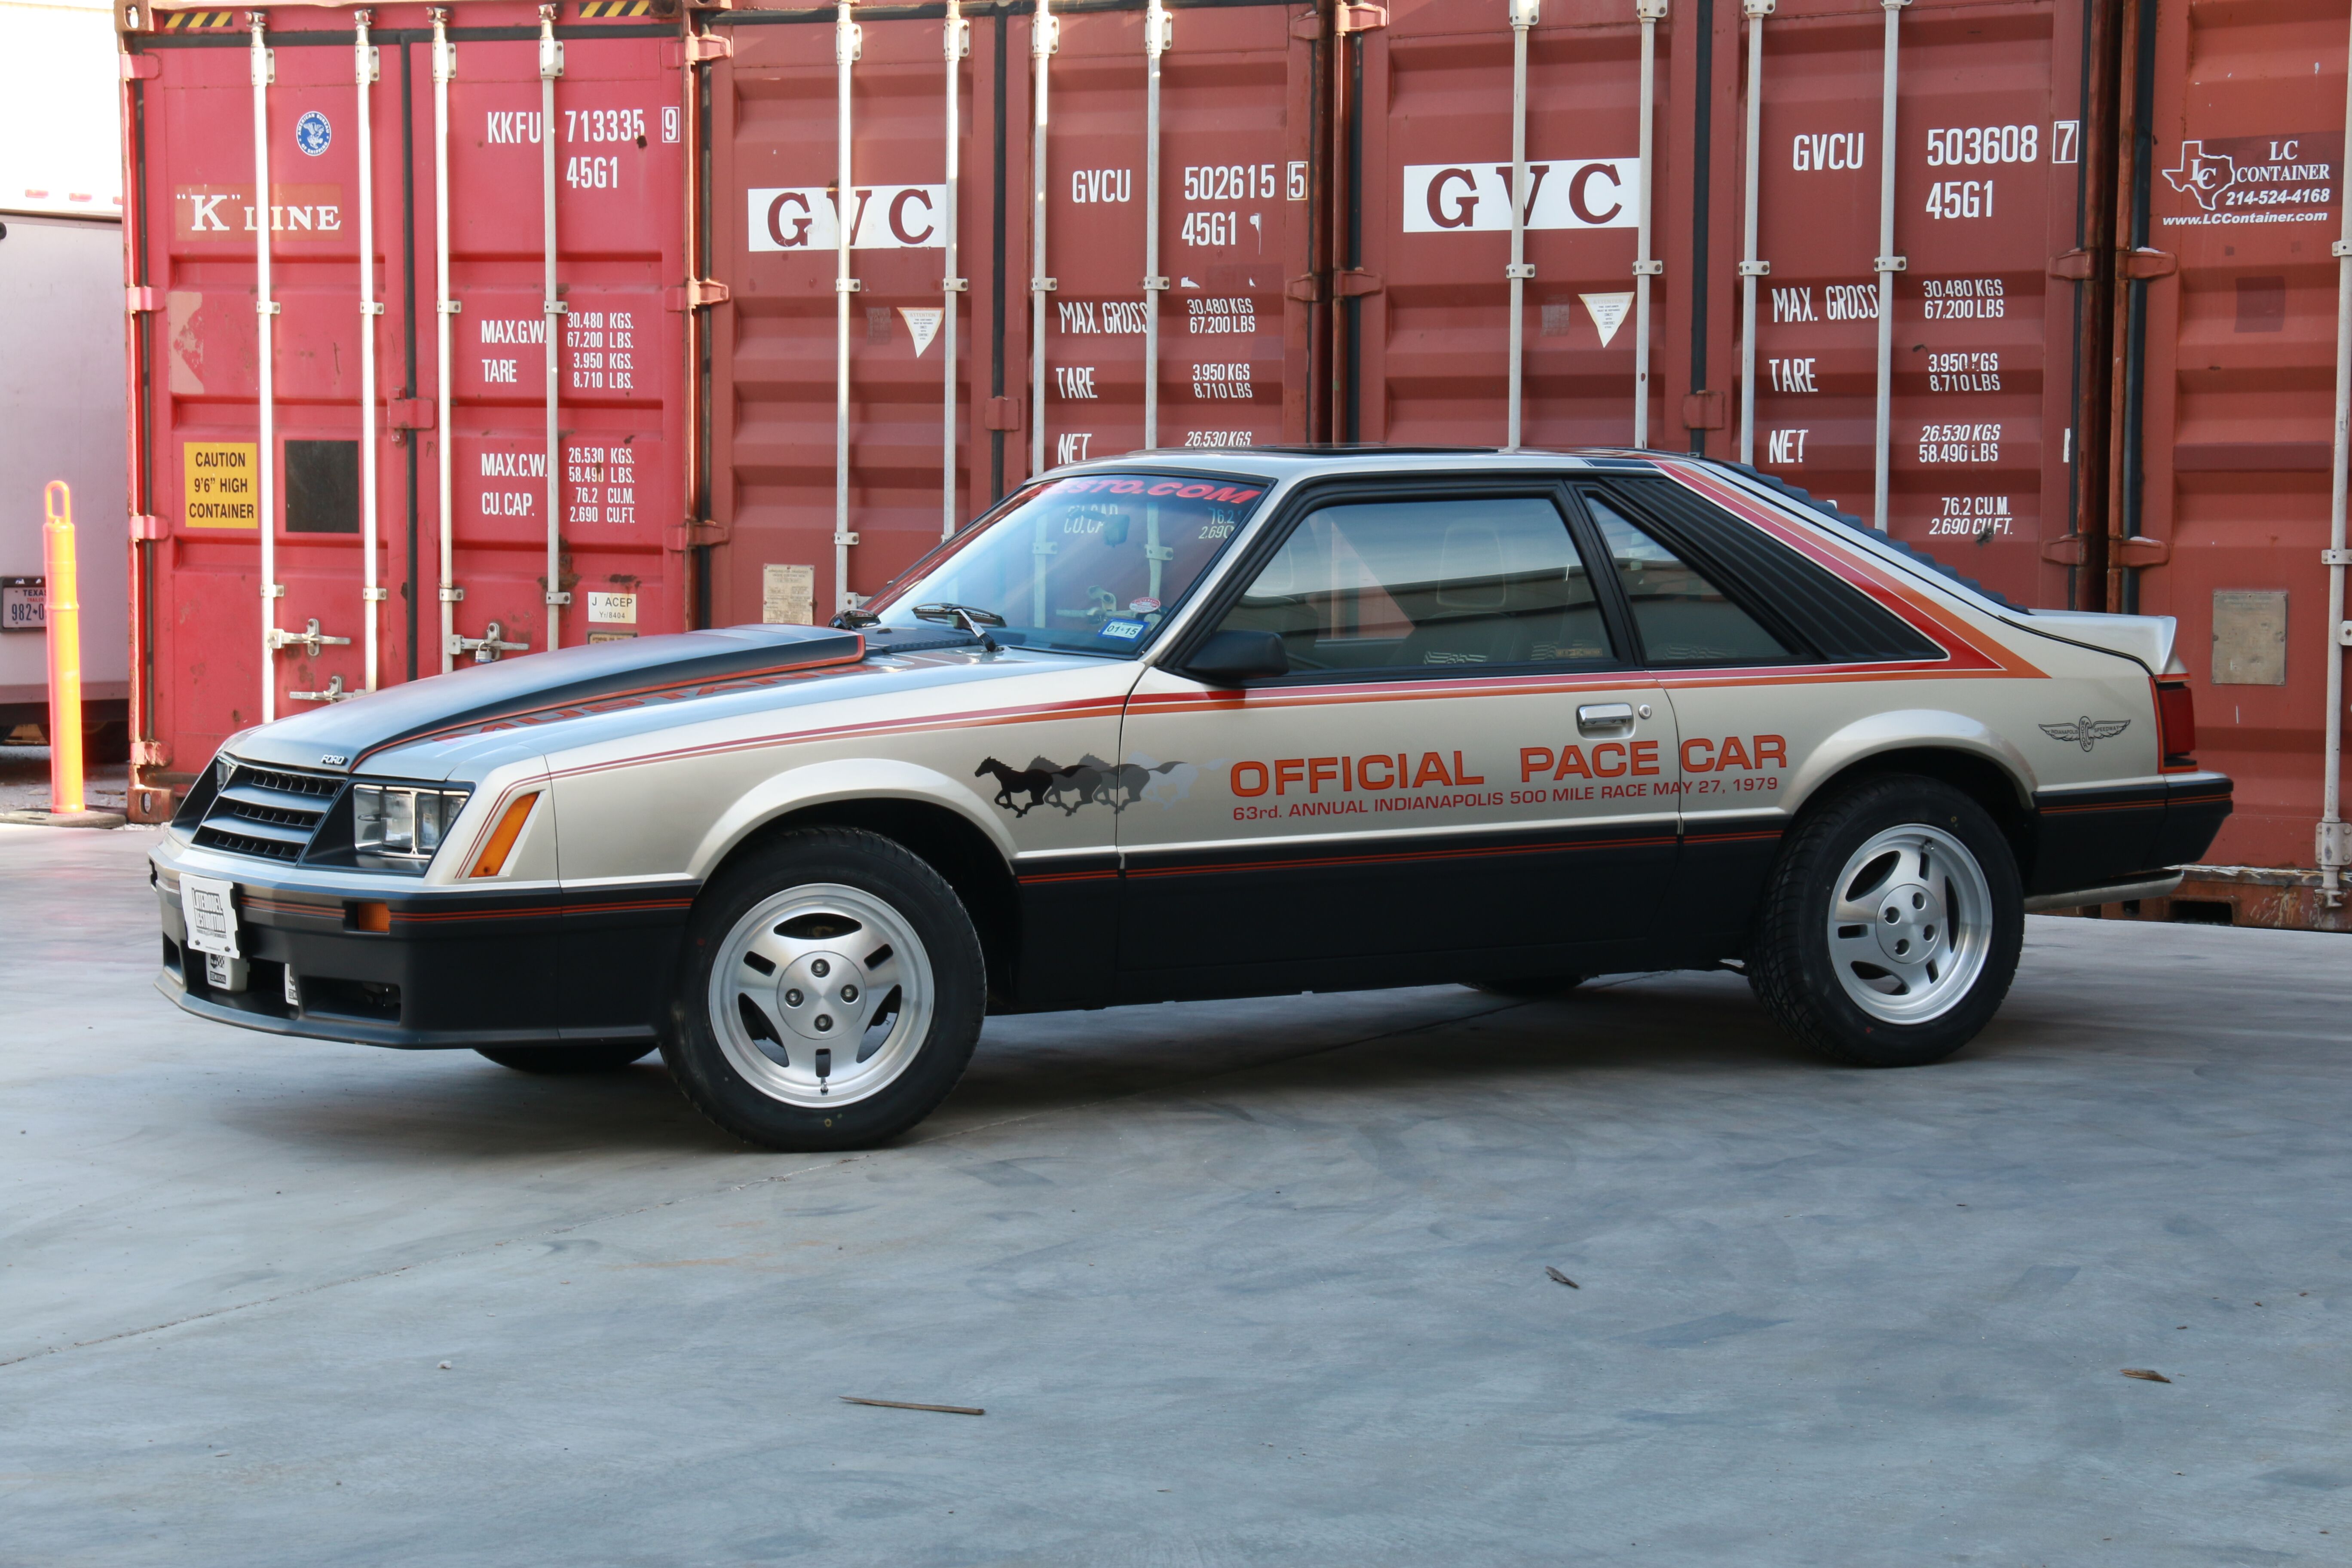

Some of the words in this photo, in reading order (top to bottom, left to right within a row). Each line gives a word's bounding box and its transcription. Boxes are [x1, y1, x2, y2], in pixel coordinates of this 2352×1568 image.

[298, 113, 315, 135] AMERICAN
[316, 114, 329, 133] BUREAU
[487, 112, 541, 143] KKFU
[565, 109, 645, 142] 713335
[664, 108, 678, 141] 9
[307, 141, 328, 154] SHIPPING
[1792, 132, 1864, 171] GVCU
[1927, 125, 2037, 166] 503608
[2055, 122, 2077, 162] 7
[2269, 141, 2298, 160] LC
[567, 156, 618, 189] 45G1
[2237, 164, 2330, 183] CONTAINER
[1072, 169, 1130, 203] GVCU
[1185, 164, 1275, 200] 502615
[1289, 162, 1306, 199] 5
[1926, 180, 1993, 219] 45G1
[2226, 188, 2330, 205] 214-524-4168
[244, 205, 340, 230] LINE
[2163, 212, 2327, 225] www.LCContainer.com
[1182, 211, 1235, 246] 45G1
[1923, 280, 1972, 298] 30,480
[1975, 279, 2003, 297] KGS
[1187, 299, 1228, 315] 30,480
[1229, 298, 1253, 313] KGS
[1772, 287, 1818, 322] MAX.
[1826, 285, 1879, 320] GROSS
[1925, 300, 1974, 319] 67,200
[1977, 299, 2004, 318] LBS
[567, 312, 603, 328] 30,480
[609, 312, 634, 329] KGS.
[1058, 302, 1100, 333] MAX.
[1102, 302, 1147, 334] GROSS
[1190, 316, 1230, 333] 67,200
[1233, 316, 1255, 332] LBS
[481, 320, 546, 343] MAX.G.W.
[567, 331, 603, 348] 67,200
[609, 332, 634, 348] LBS.
[573, 352, 603, 369] 3,950
[609, 353, 633, 369] KGS.
[1928, 353, 1968, 372] 3,950
[482, 359, 517, 383] TARE
[573, 372, 603, 388] 8,710
[609, 373, 633, 389] LBS.
[1192, 364, 1225, 381] 3,950
[1228, 364, 1250, 380] KGS
[1769, 358, 1818, 392] TARE
[1056, 367, 1097, 398] TARE
[1193, 383, 1227, 398] 8,710
[1227, 383, 1253, 398] LBS
[1929, 374, 1969, 391] 8,710
[1972, 374, 2000, 391] LBS
[1185, 431, 1227, 447] 26,530
[1228, 432, 1252, 446] KGS
[1920, 425, 1971, 442] 26,530
[1972, 424, 2000, 441] KGS
[569, 447, 603, 463] 26,530
[611, 448, 634, 464] KGS.
[1058, 433, 1092, 464] NET
[1769, 429, 1808, 464] NET
[1919, 444, 1967, 462] 58,490
[1971, 443, 1998, 462] LBS
[196, 452, 245, 467] CAUTION
[481, 453, 547, 477] MAX.C.W.
[569, 466, 604, 482] 58,490
[611, 467, 634, 483] LBS.
[220, 478, 247, 493] HIGH
[576, 487, 597, 503] 76.2
[608, 488, 634, 504] CU.M.
[189, 503, 254, 519] CONTAINER
[570, 507, 598, 522] 2,690
[606, 507, 635, 523] CU.FT.
[1208, 507, 1234, 524] 76.2
[1941, 497, 1971, 516] 76.2
[1975, 496, 2010, 515] CU.M.
[1929, 518, 1969, 535] 2,690
[592, 597, 597, 606] J
[605, 597, 632, 607] ACEP
[321, 754, 345, 765] FORD
[1231, 750, 1484, 797] OFFICIAL
[1520, 741, 1660, 783] PACE
[1681, 735, 1786, 773] CAR
[1233, 805, 1282, 821] 63rd.
[1289, 799, 1368, 817] ANNUAL
[1375, 792, 1504, 812] INDIANAPOLIS
[1510, 790, 1546, 805] 500
[1553, 787, 1594, 802] MILE
[1601, 783, 1647, 799] RACE
[1653, 781, 1693, 796] MAY
[1699, 780, 1725, 793] 27,
[1733, 777, 1777, 791] 1979
